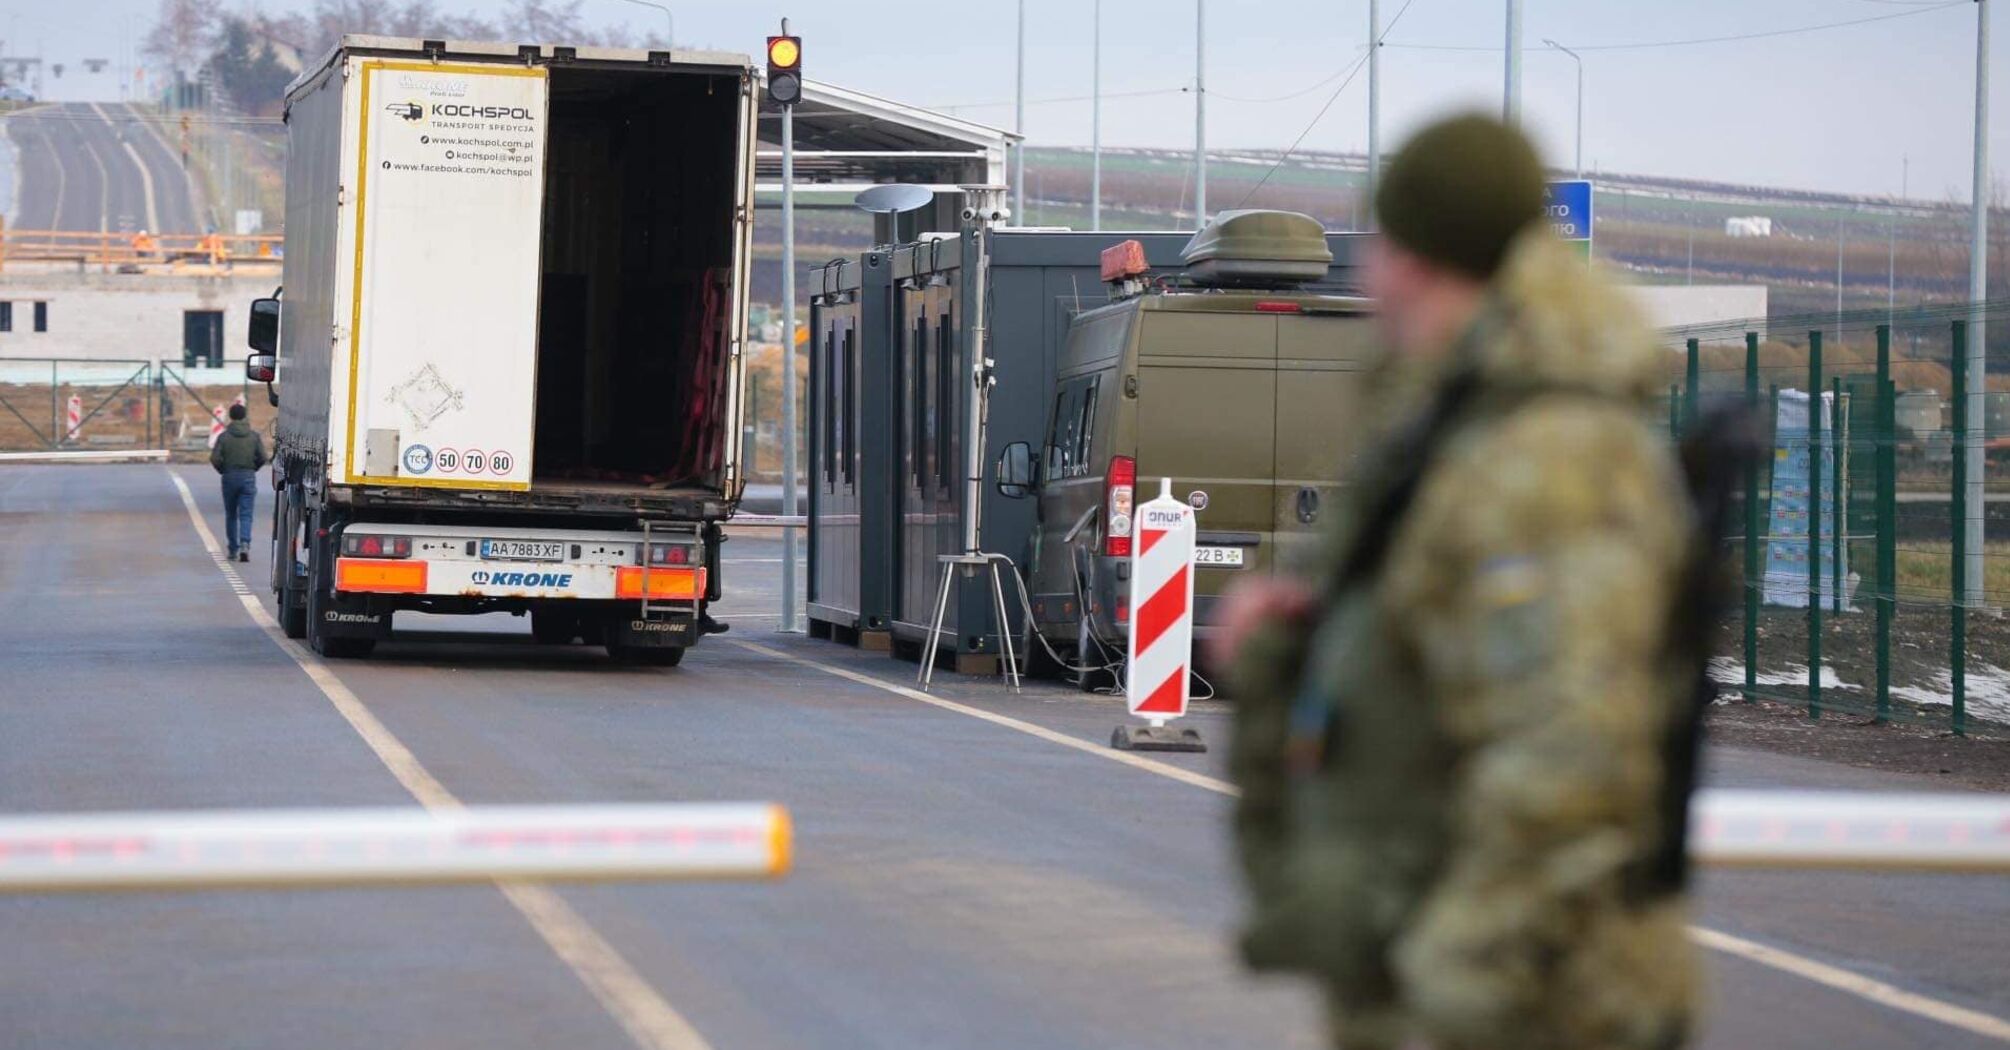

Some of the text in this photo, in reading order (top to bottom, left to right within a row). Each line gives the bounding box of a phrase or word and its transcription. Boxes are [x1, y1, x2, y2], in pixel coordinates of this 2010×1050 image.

[431, 104, 535, 121] KOCHSPOL
[431, 121, 535, 133] TRANSPORT SPEDYCJA
[431, 136, 534, 149] www.kochspol.com.pl
[394, 164, 533, 178] www.facebook.com/kochspol
[439, 453, 456, 468] 50
[466, 455, 483, 469] 70
[493, 456, 509, 471] 80
[491, 543, 509, 556] AA
[511, 543, 541, 557] 7883
[542, 544, 561, 558] XF
[491, 572, 573, 588] KRONE
[645, 623, 687, 632] KRONE
